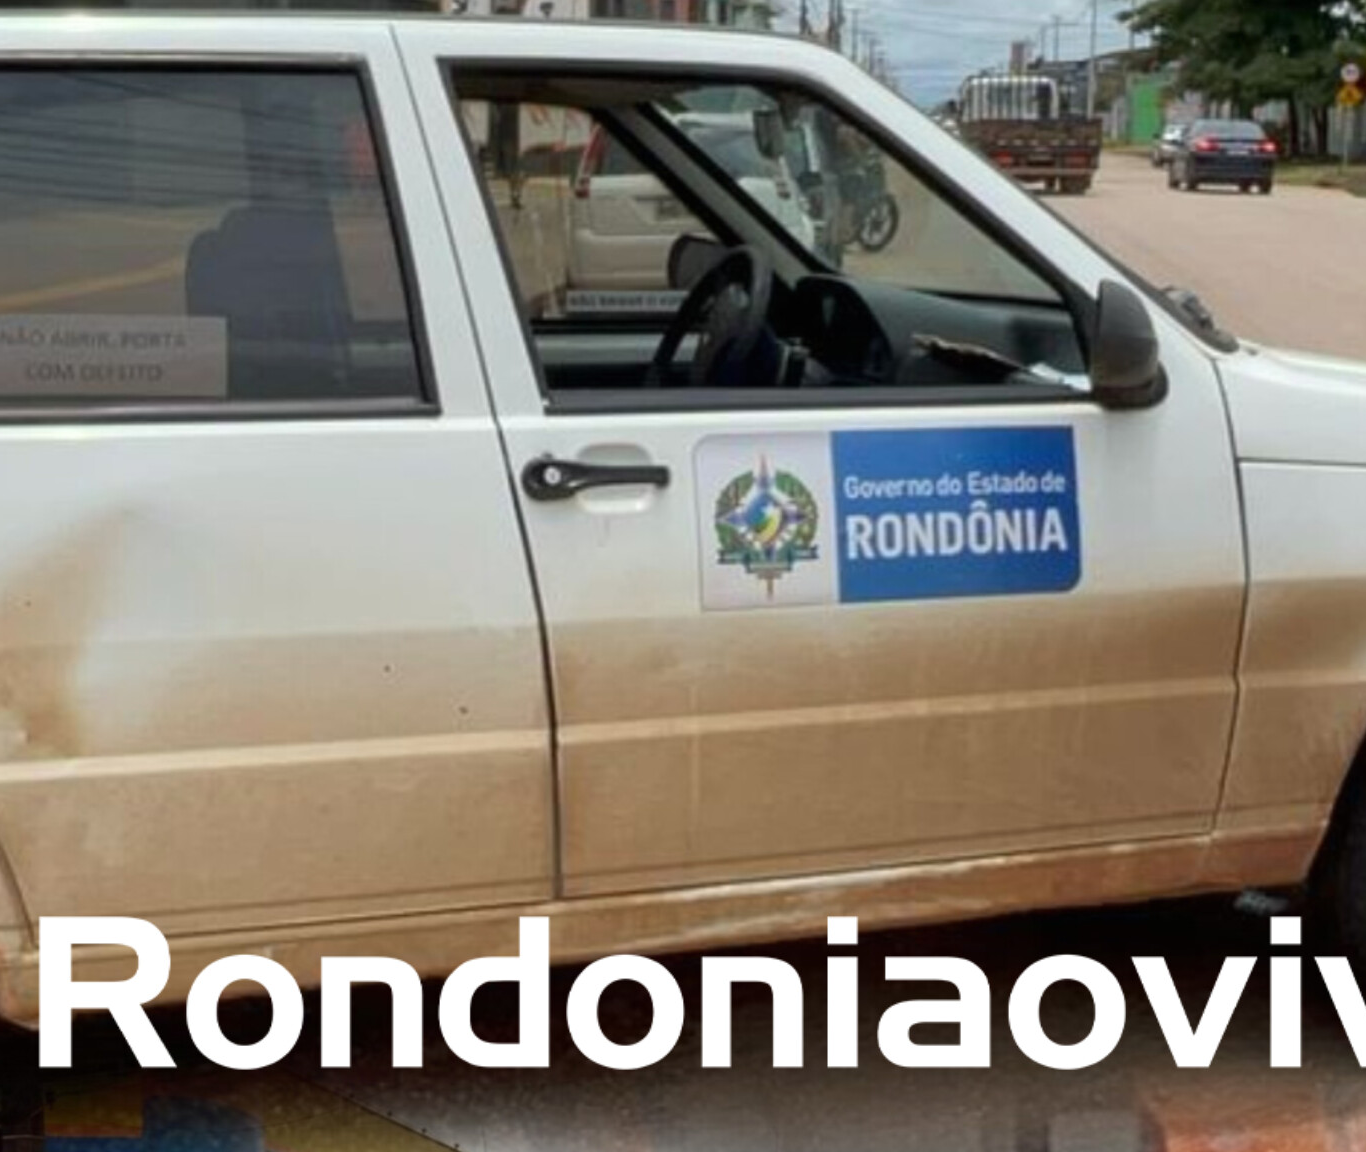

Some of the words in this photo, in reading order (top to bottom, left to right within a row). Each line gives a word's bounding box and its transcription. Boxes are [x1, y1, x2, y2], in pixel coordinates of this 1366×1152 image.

[843, 475, 934, 500] Governo
[936, 472, 962, 495] do
[966, 470, 1039, 494] Estado
[1040, 469, 1067, 492] de
[846, 499, 1069, 560] RONDÔNIA
